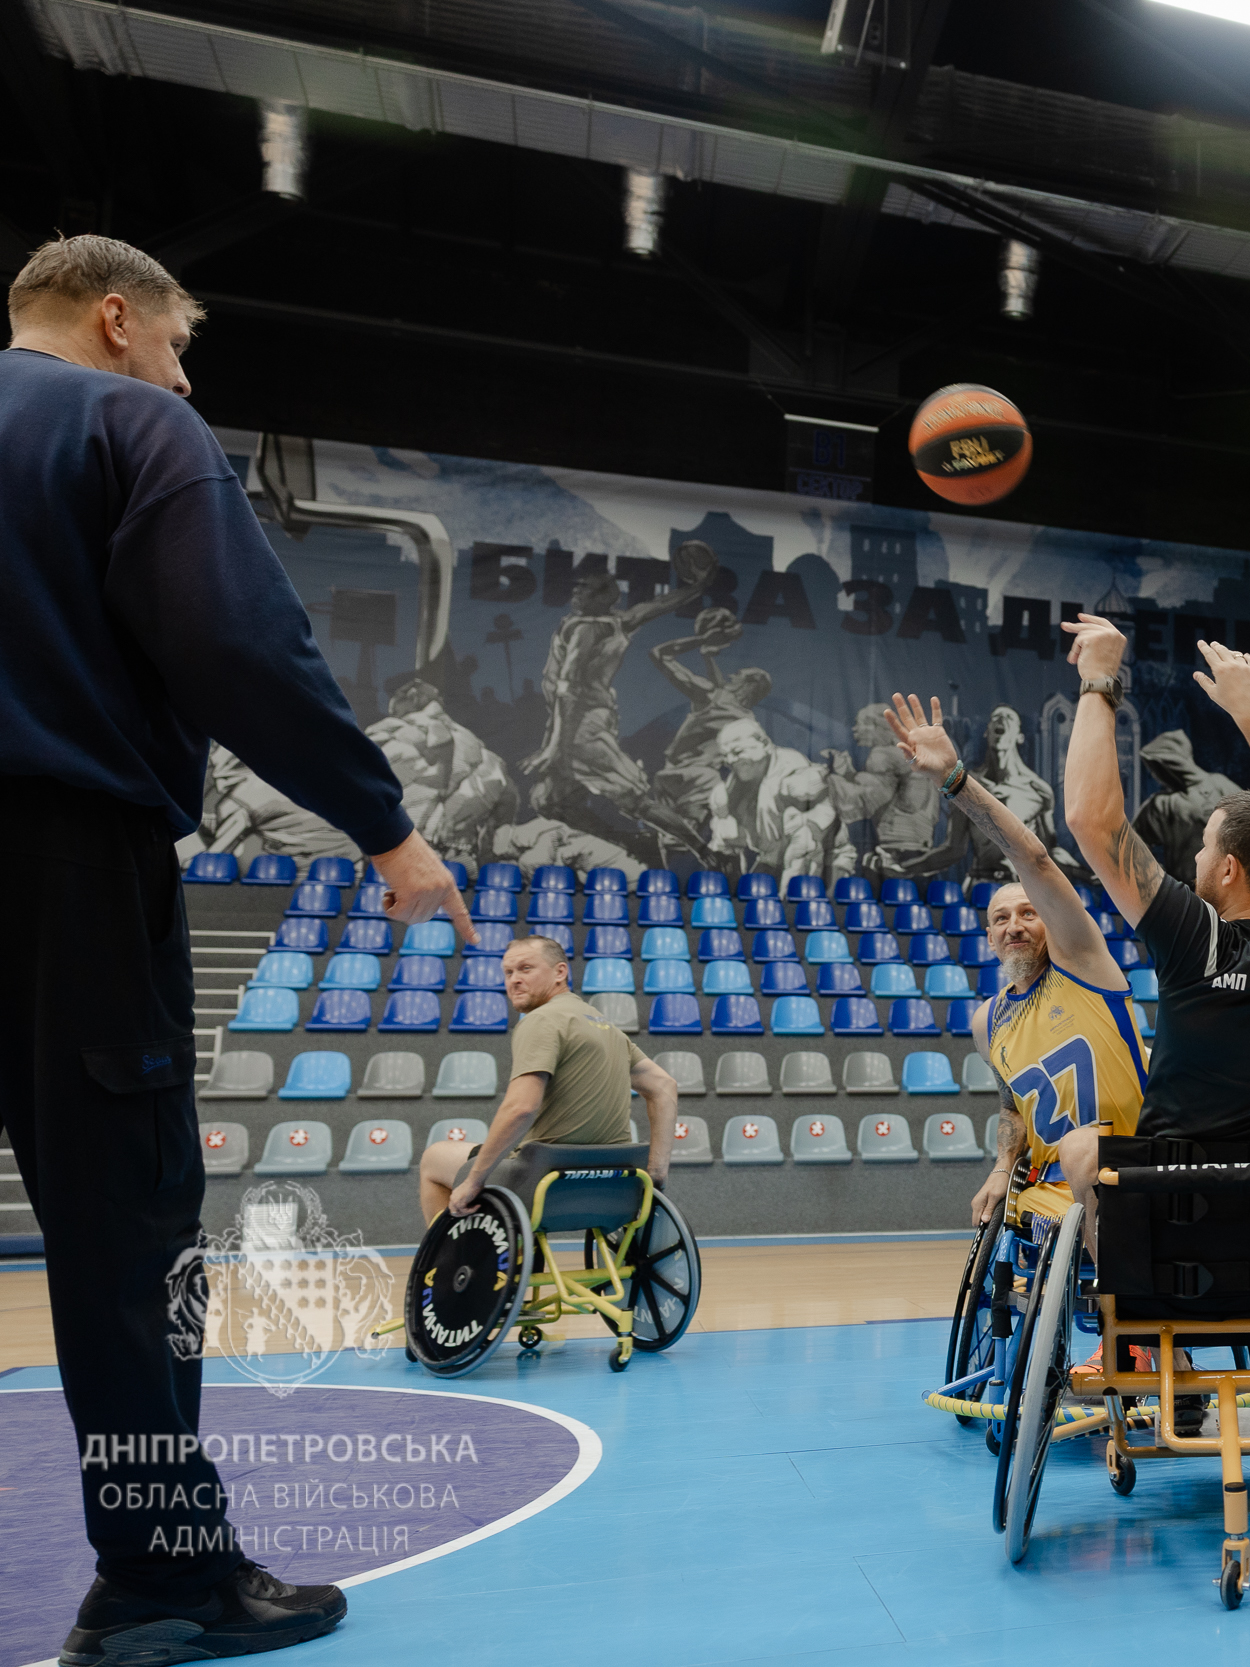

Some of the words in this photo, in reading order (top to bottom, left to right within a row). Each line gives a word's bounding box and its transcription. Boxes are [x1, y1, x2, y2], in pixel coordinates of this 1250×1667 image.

[840, 579, 967, 643] ЗА
[1211, 973, 1248, 991] АМП
[1007, 1033, 1100, 1147] 27
